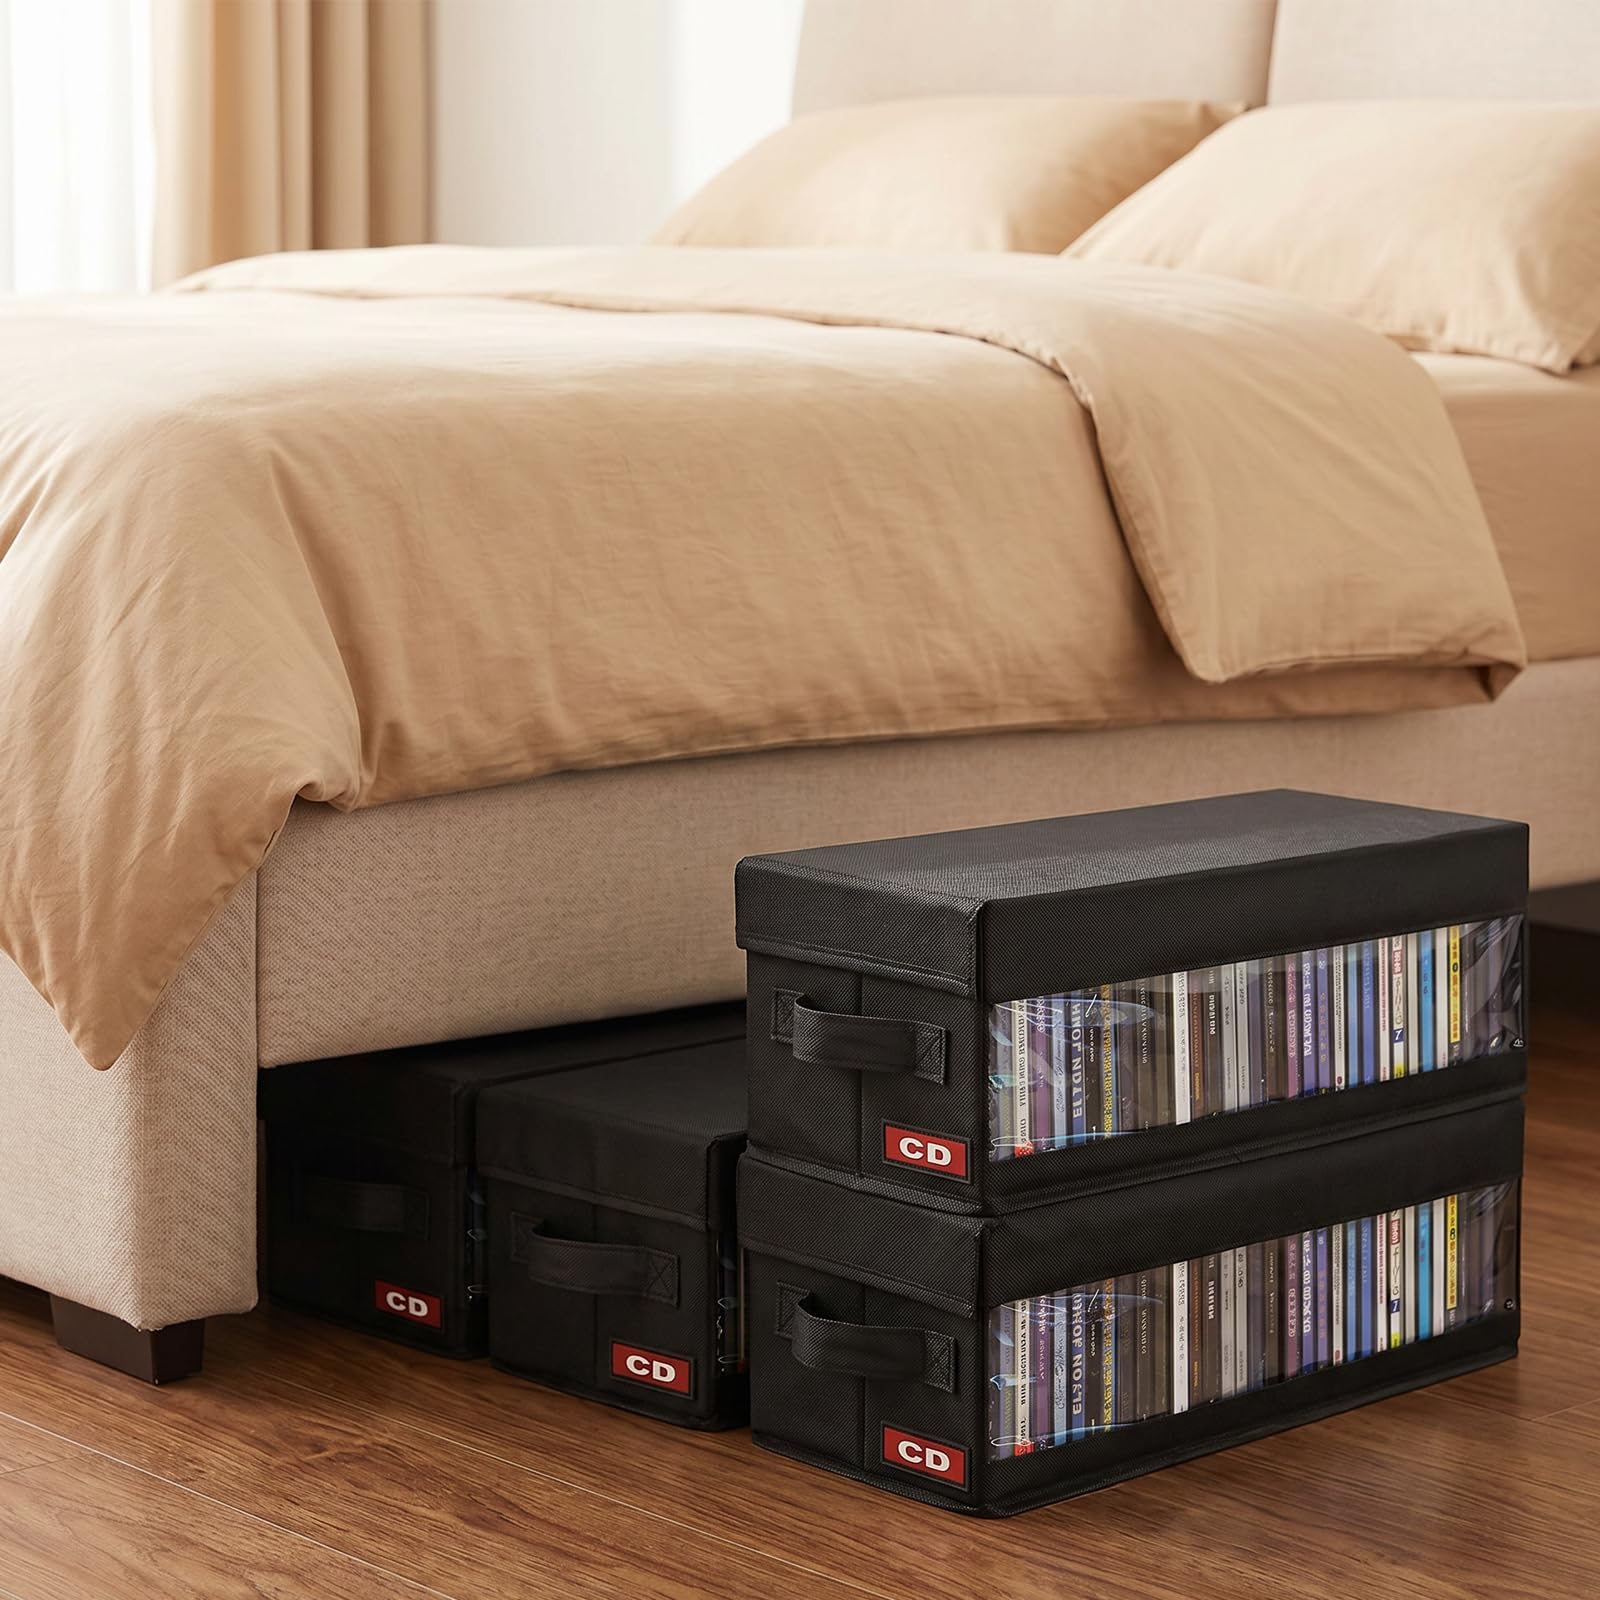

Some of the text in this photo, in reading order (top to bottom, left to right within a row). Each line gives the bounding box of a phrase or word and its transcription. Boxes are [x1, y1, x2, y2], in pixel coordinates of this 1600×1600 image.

[898, 1136, 953, 1167] CD
[385, 1290, 429, 1318] CD
[624, 1354, 677, 1384] CD
[896, 1439, 951, 1473] CD
